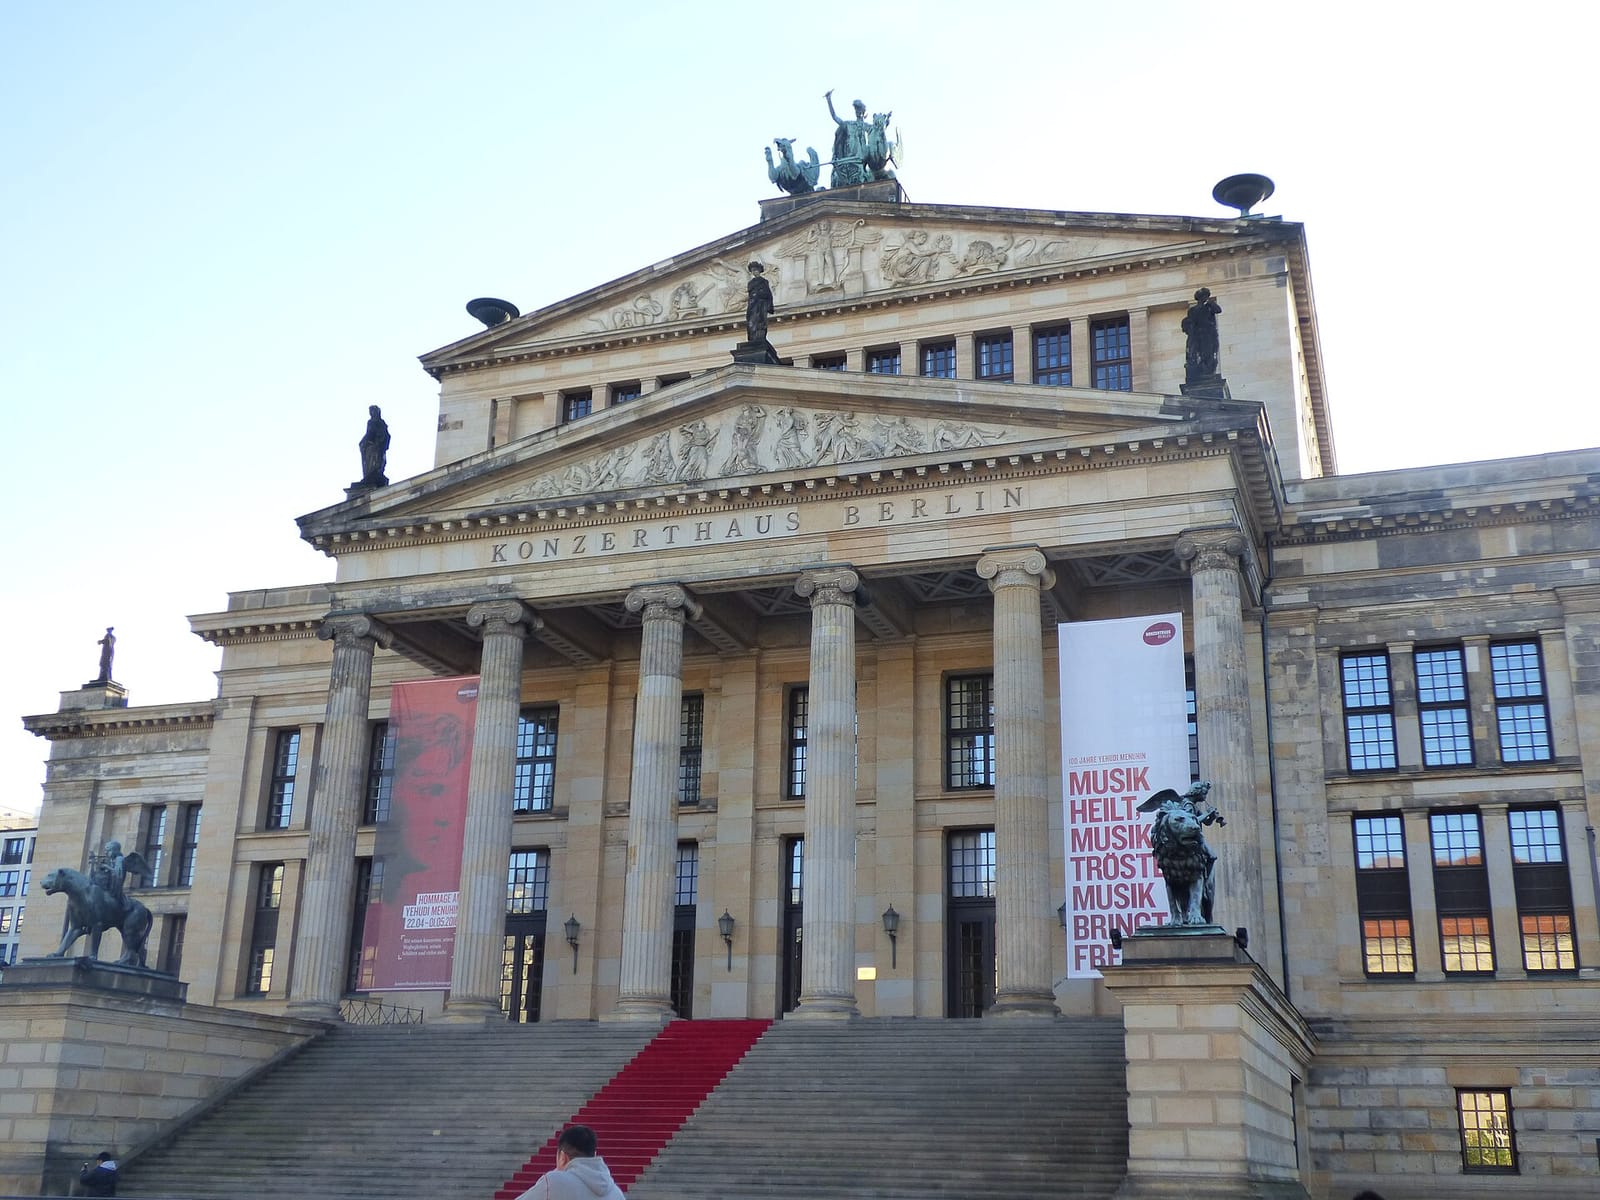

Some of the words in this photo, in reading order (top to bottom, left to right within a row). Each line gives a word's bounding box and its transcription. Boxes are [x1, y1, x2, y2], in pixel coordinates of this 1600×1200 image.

[491, 511, 801, 563] KONZERTHAUS
[843, 486, 1023, 525] BERLIN
[1068, 757, 1079, 765] 100
[1080, 755, 1097, 764] JAHRE
[1098, 754, 1119, 763] YEHUDI
[1120, 752, 1147, 761] MENUHIN
[1069, 766, 1151, 796] MUSIK
[1070, 796, 1141, 824] HEILT,
[1071, 824, 1153, 853] MUSIK
[418, 894, 452, 905] HOMMAGE
[1073, 882, 1156, 911] MUSIK
[405, 906, 430, 917] YEHUDI
